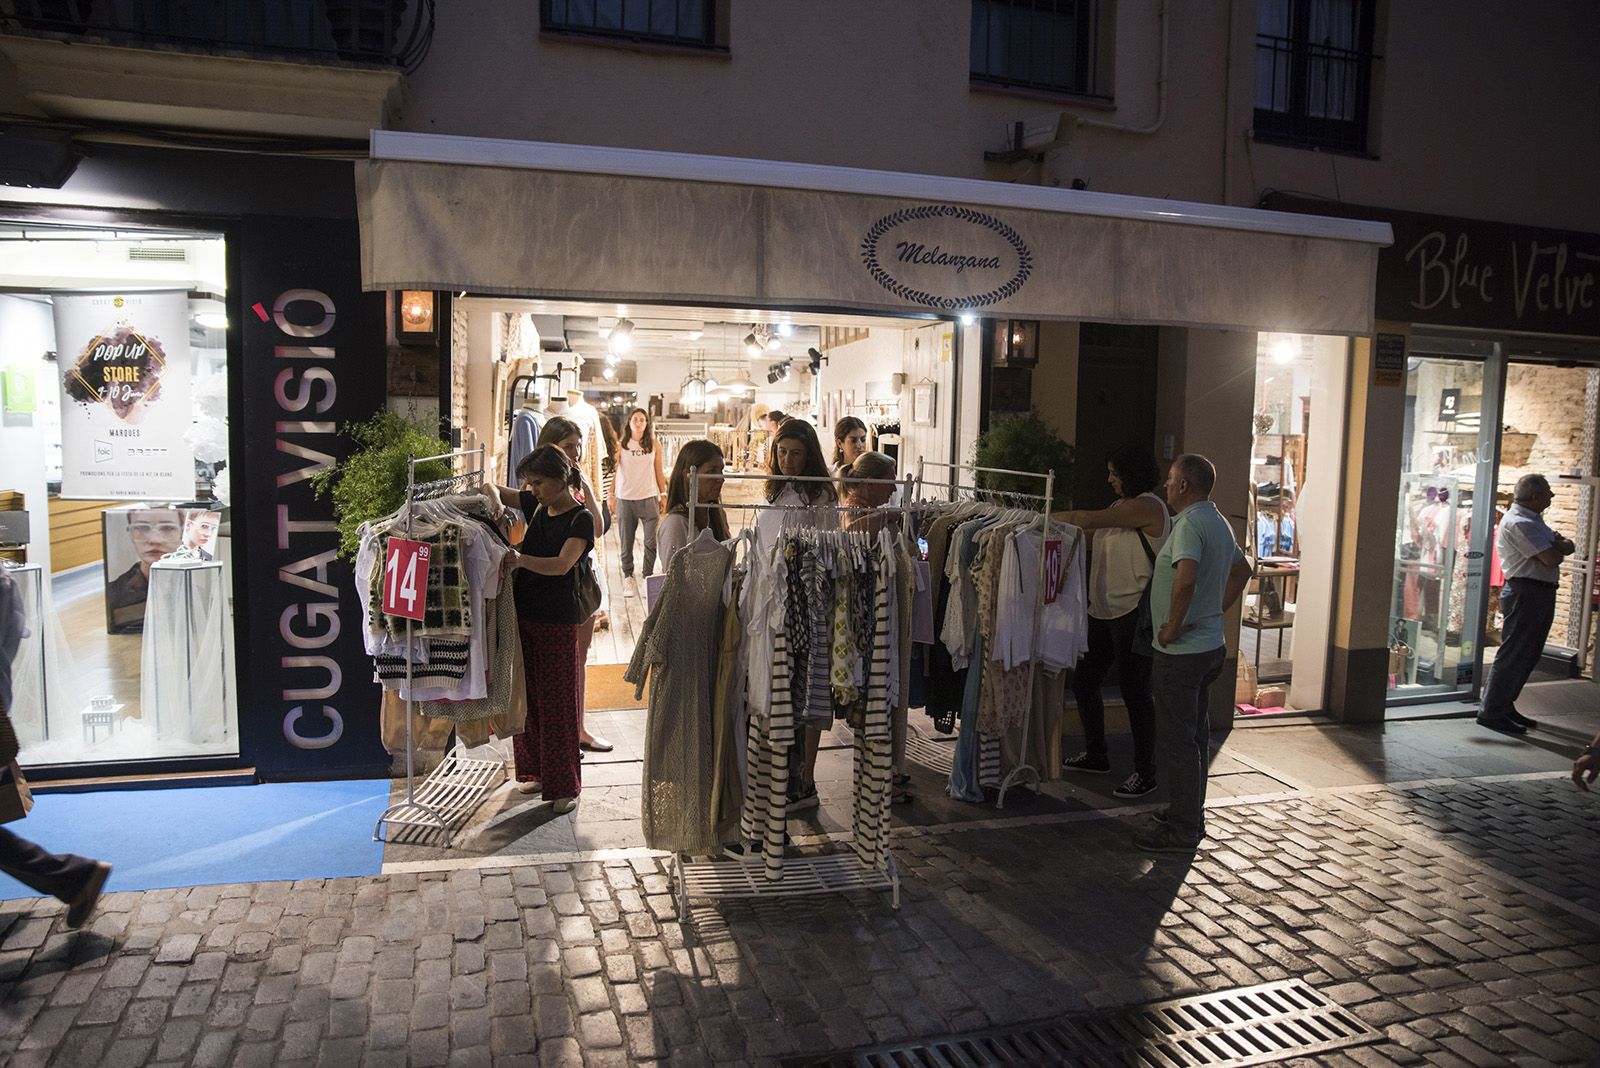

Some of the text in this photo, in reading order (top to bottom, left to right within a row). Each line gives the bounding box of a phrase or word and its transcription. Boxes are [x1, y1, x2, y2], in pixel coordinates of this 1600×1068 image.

[896, 241, 1000, 274] Melanzana
[1405, 231, 1600, 319] Blue Velve
[94, 343, 146, 361] POP UP
[103, 366, 140, 382] STORE
[109, 429, 140, 437] MARQUES
[387, 546, 429, 612] 14 99
